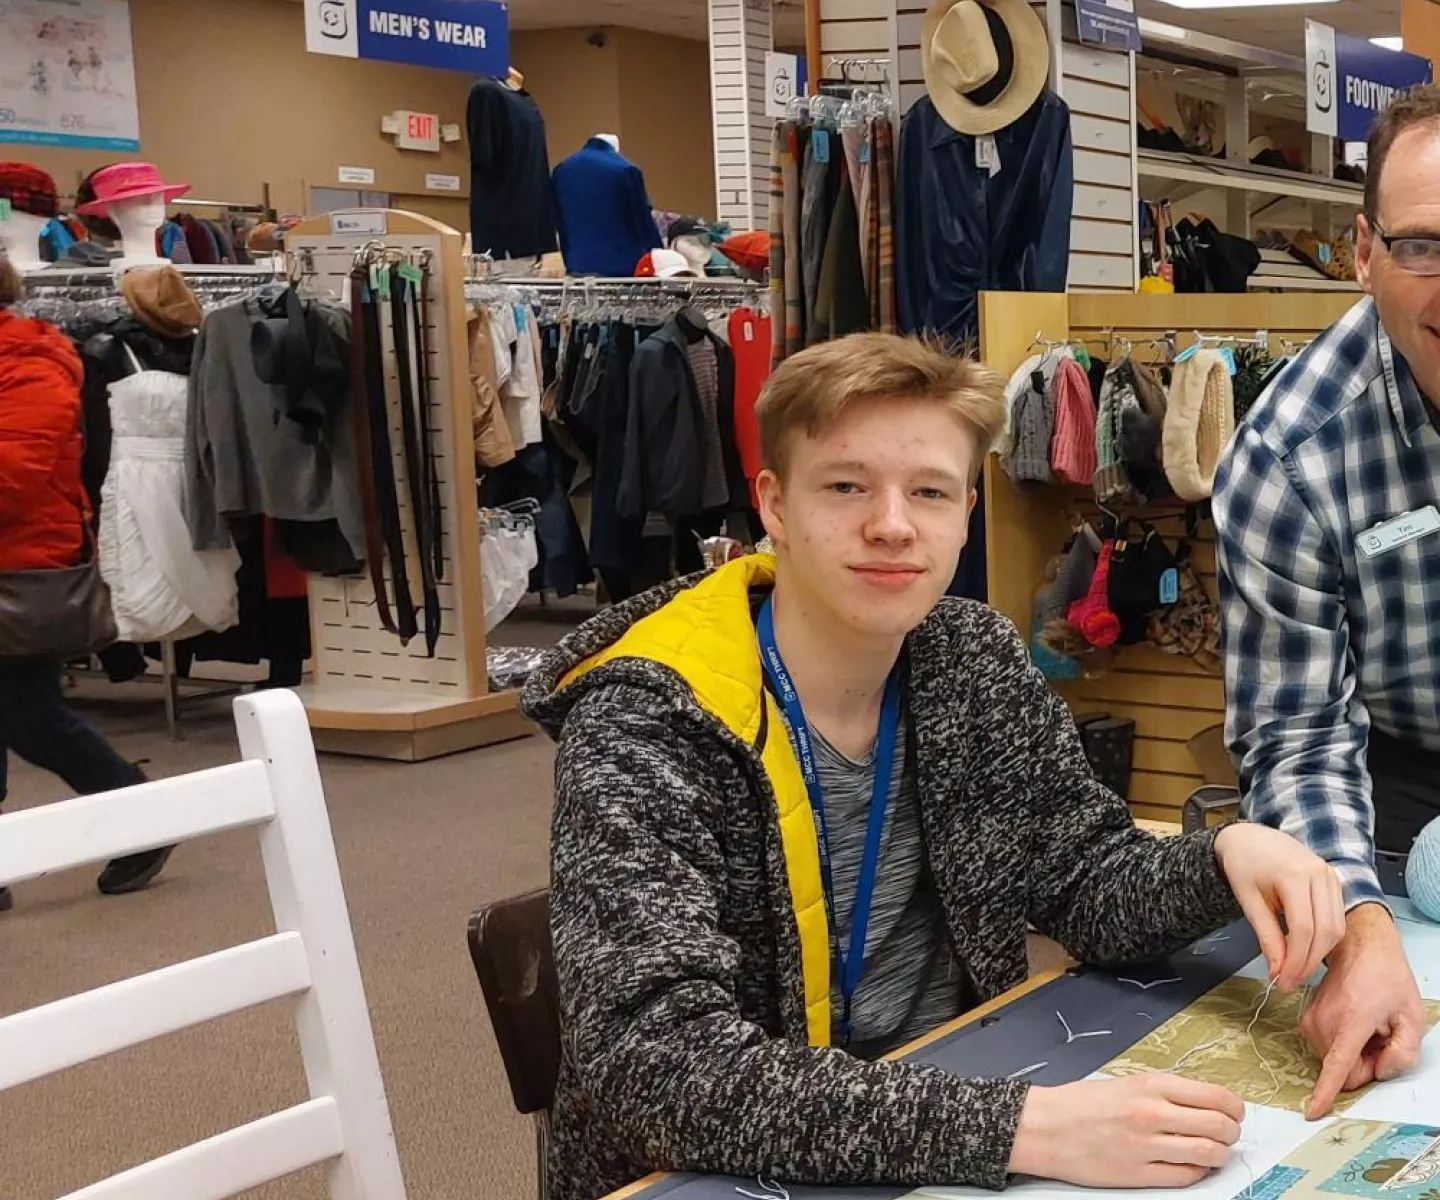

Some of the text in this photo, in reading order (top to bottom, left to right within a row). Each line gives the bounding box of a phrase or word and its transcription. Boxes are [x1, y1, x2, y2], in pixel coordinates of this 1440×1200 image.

[369, 10, 486, 49] MEN'S WEAR
[407, 113, 433, 140] EXIT
[803, 755, 813, 776] MCC
